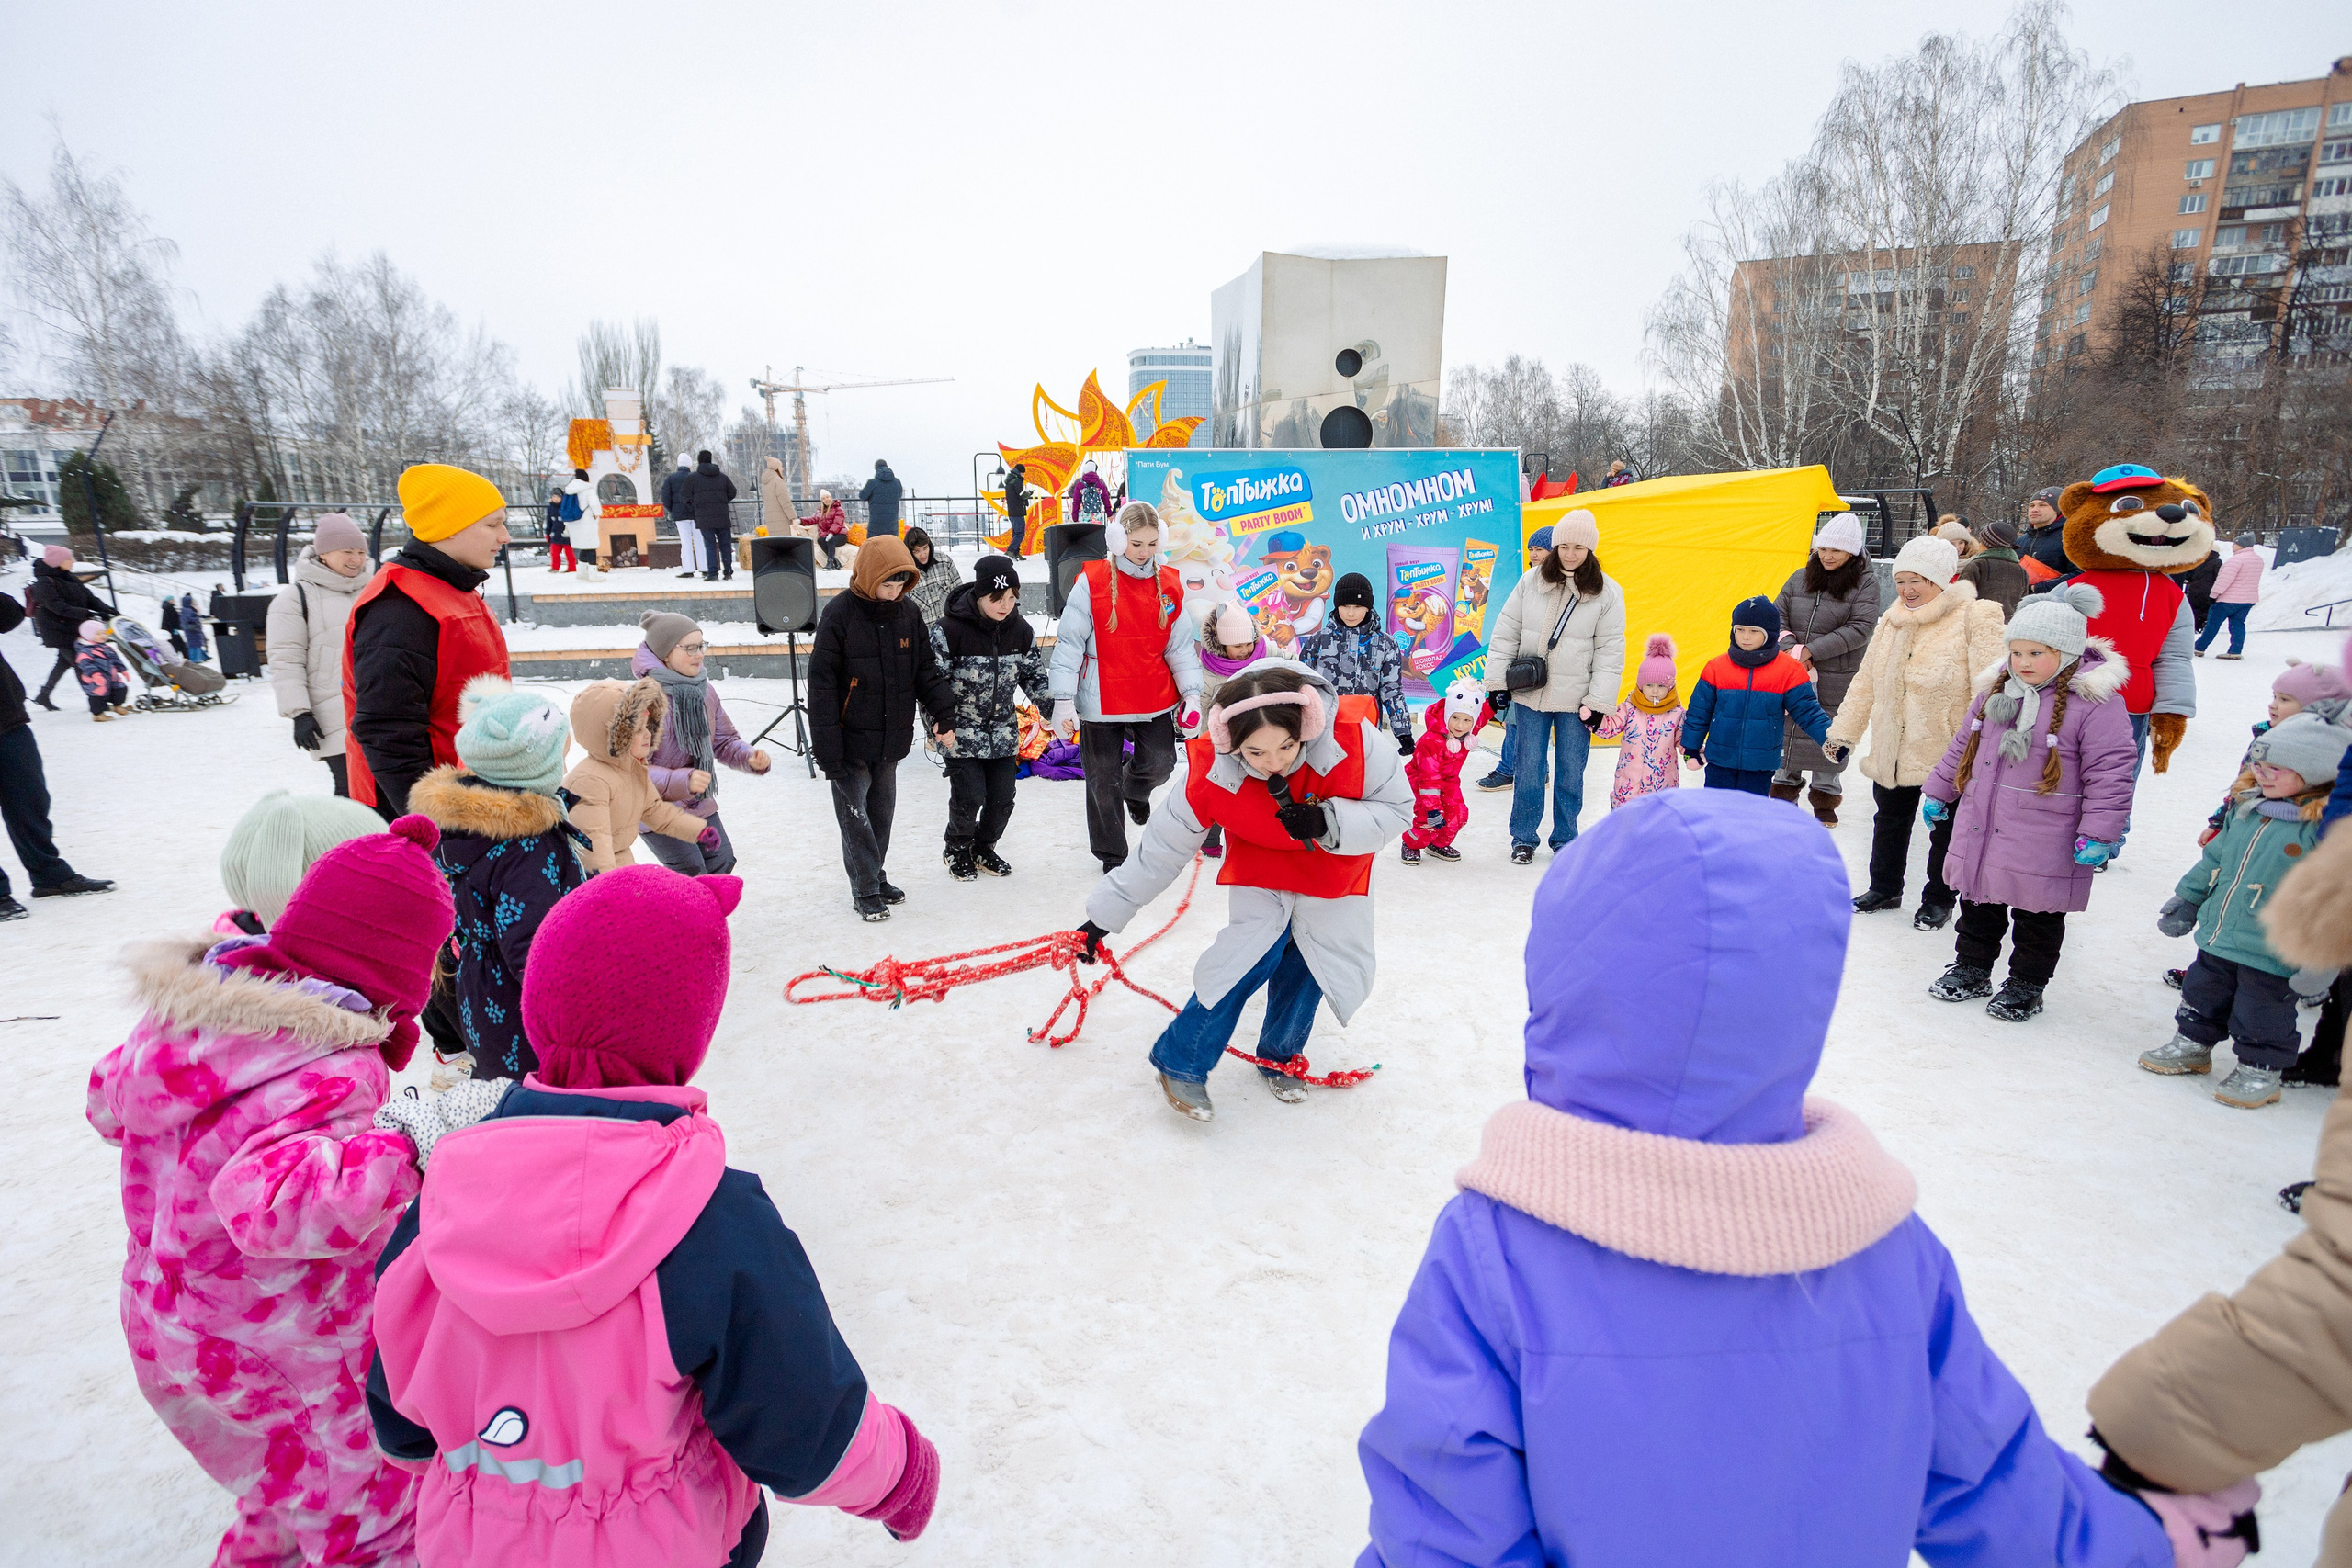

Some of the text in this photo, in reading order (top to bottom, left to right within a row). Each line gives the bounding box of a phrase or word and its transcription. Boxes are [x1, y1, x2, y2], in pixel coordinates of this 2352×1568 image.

[1156, 460, 1170, 469] Бум
[1340, 467, 1477, 524] ОМНОМНОМ
[1240, 514, 1271, 532] PARTY
[1361, 525, 1372, 541] И
[1373, 517, 1408, 538] ХРУМ
[1415, 508, 1450, 528] ХРУМ
[1457, 497, 1495, 519] ХРУМ!
[993, 574, 1009, 590] NY
[1416, 661, 1435, 671] КОКОС
